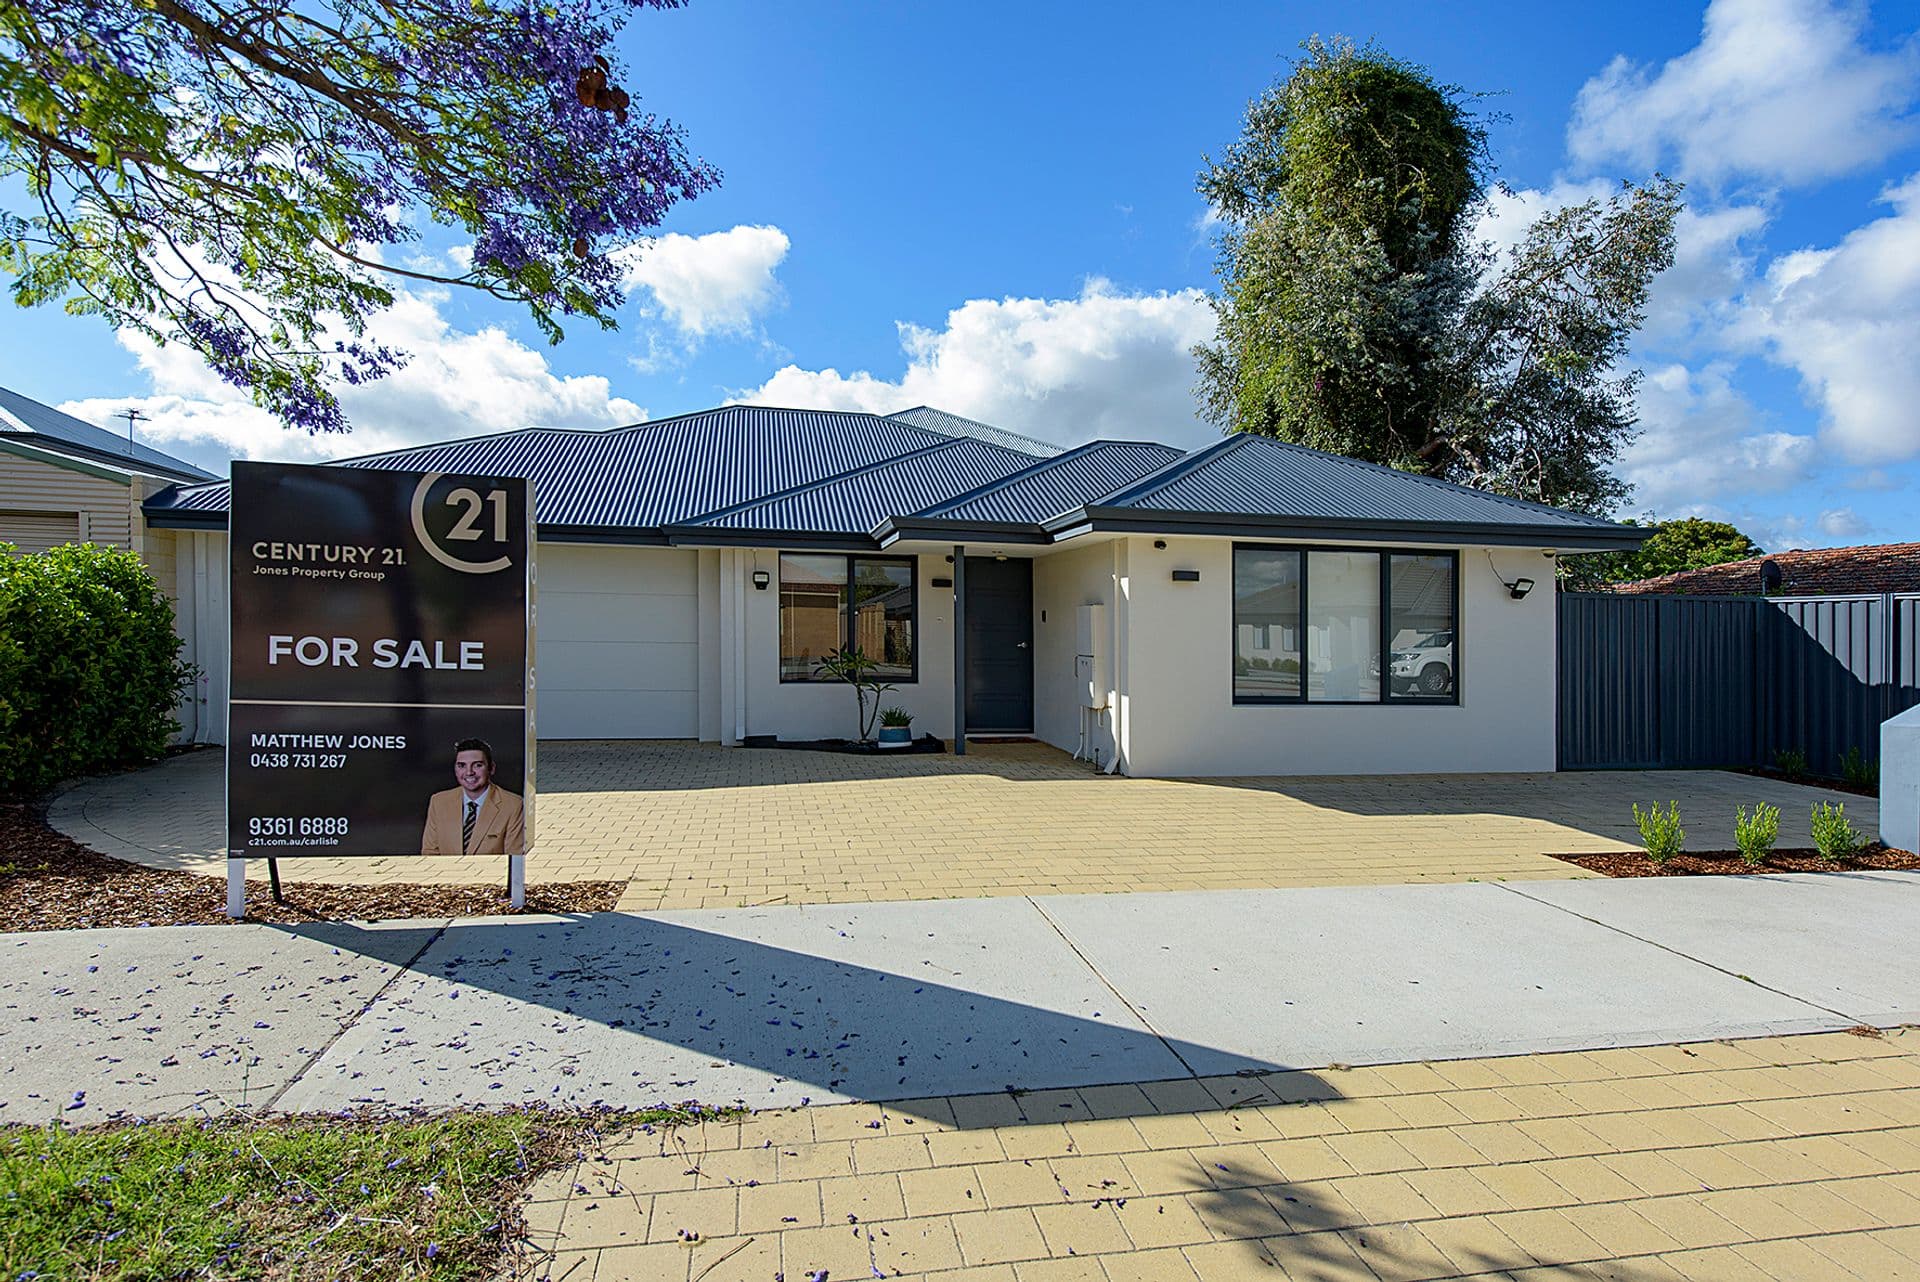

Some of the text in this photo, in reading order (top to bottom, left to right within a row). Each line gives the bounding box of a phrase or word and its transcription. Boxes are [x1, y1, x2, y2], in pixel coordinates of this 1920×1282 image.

[252, 541, 375, 564] CENTURY
[253, 565, 386, 582] Jones Property Group
[269, 635, 484, 670] FOR SALE
[251, 734, 407, 749] MATTHEW JONES
[250, 753, 347, 769] 0438 731 267
[249, 817, 348, 835] 9361 6888
[248, 837, 339, 846] c21.com.au/carlisle
